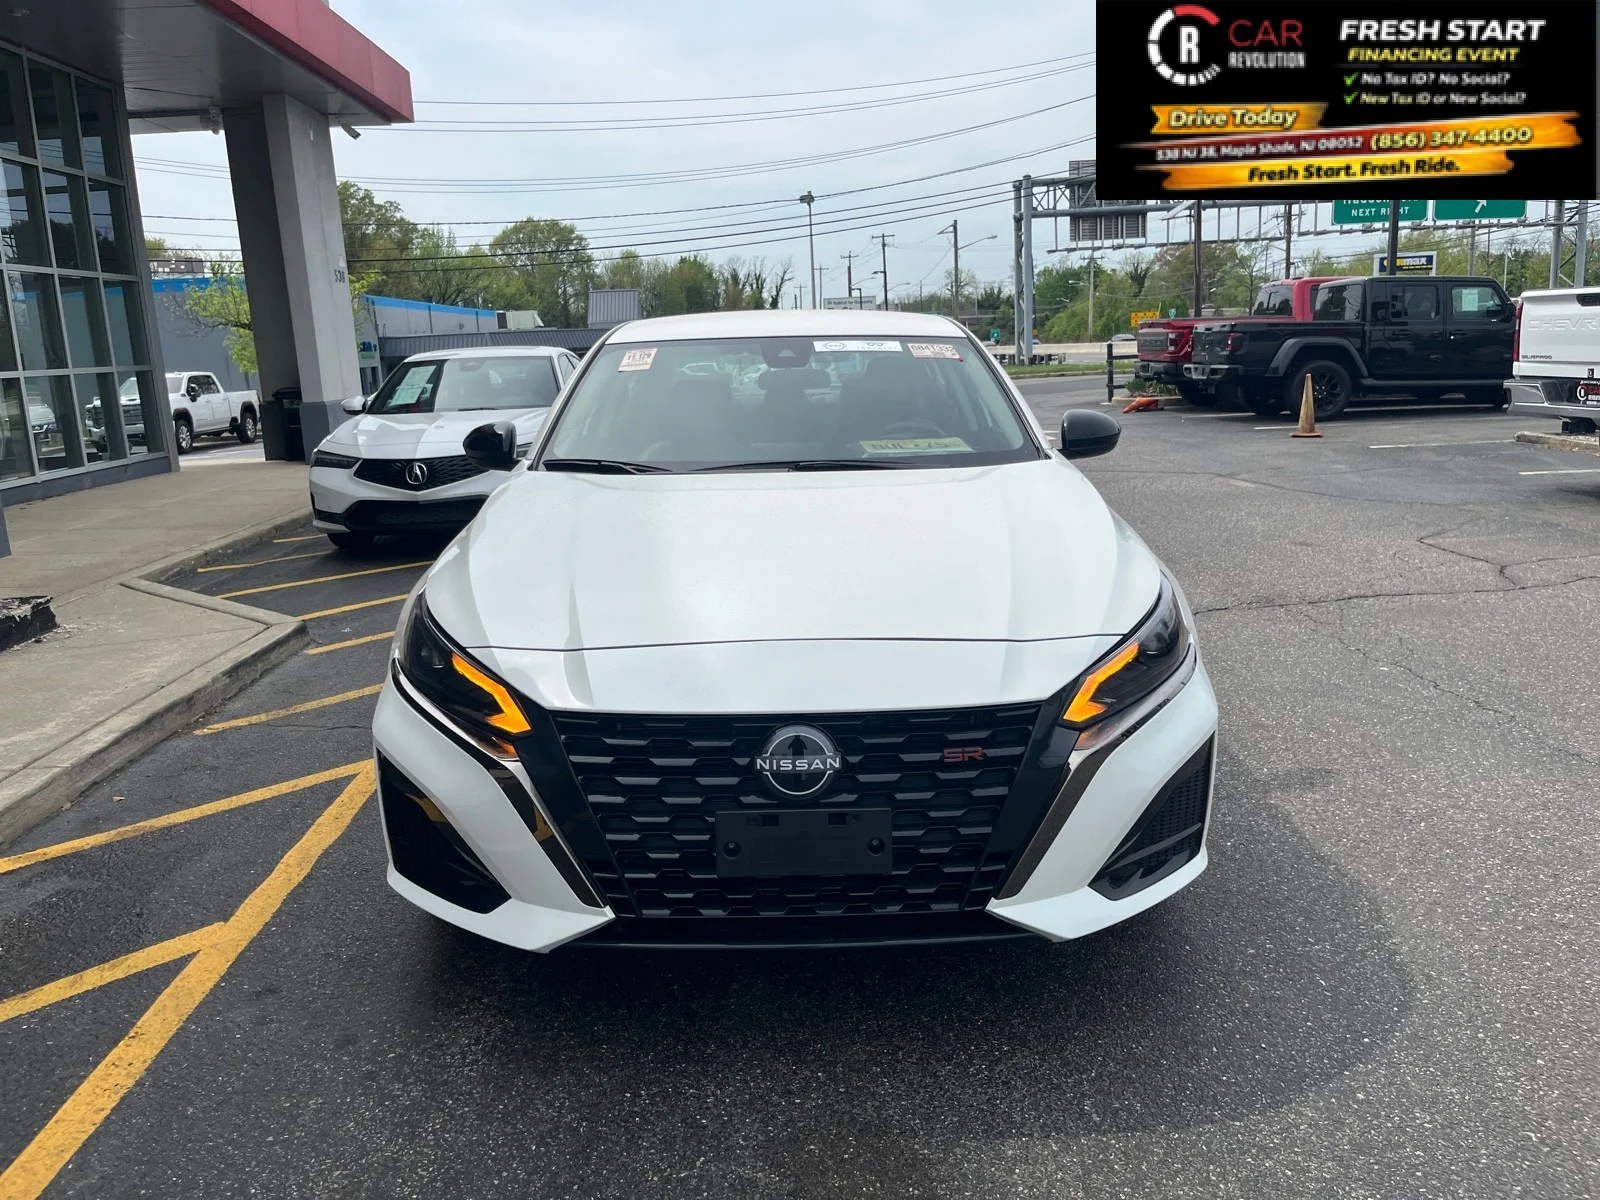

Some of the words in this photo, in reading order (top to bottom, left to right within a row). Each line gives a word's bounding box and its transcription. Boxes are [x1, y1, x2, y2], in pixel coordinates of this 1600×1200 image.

[1351, 208, 1376, 217] NEXT
[1381, 206, 1410, 215] RIHT
[943, 747, 984, 763] SR
[756, 757, 840, 771] NISSAN
